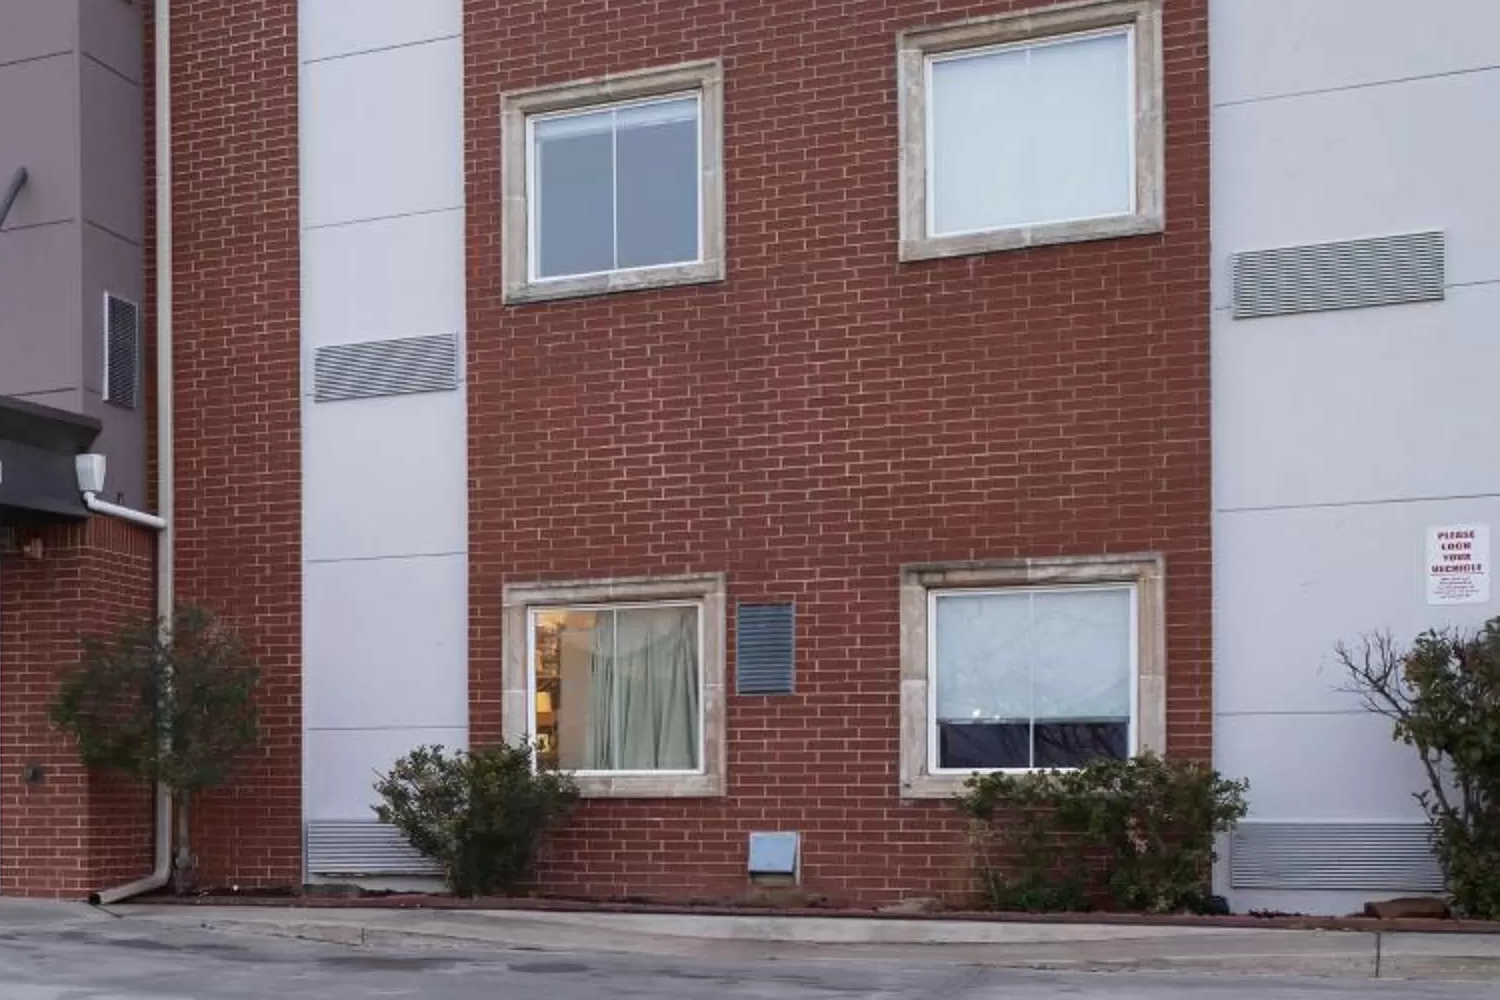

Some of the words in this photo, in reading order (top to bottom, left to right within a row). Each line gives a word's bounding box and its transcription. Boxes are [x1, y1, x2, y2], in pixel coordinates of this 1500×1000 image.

[1437, 530, 1476, 539] PLEASE
[1441, 541, 1472, 551] LOCK
[1443, 553, 1472, 562] YOUR
